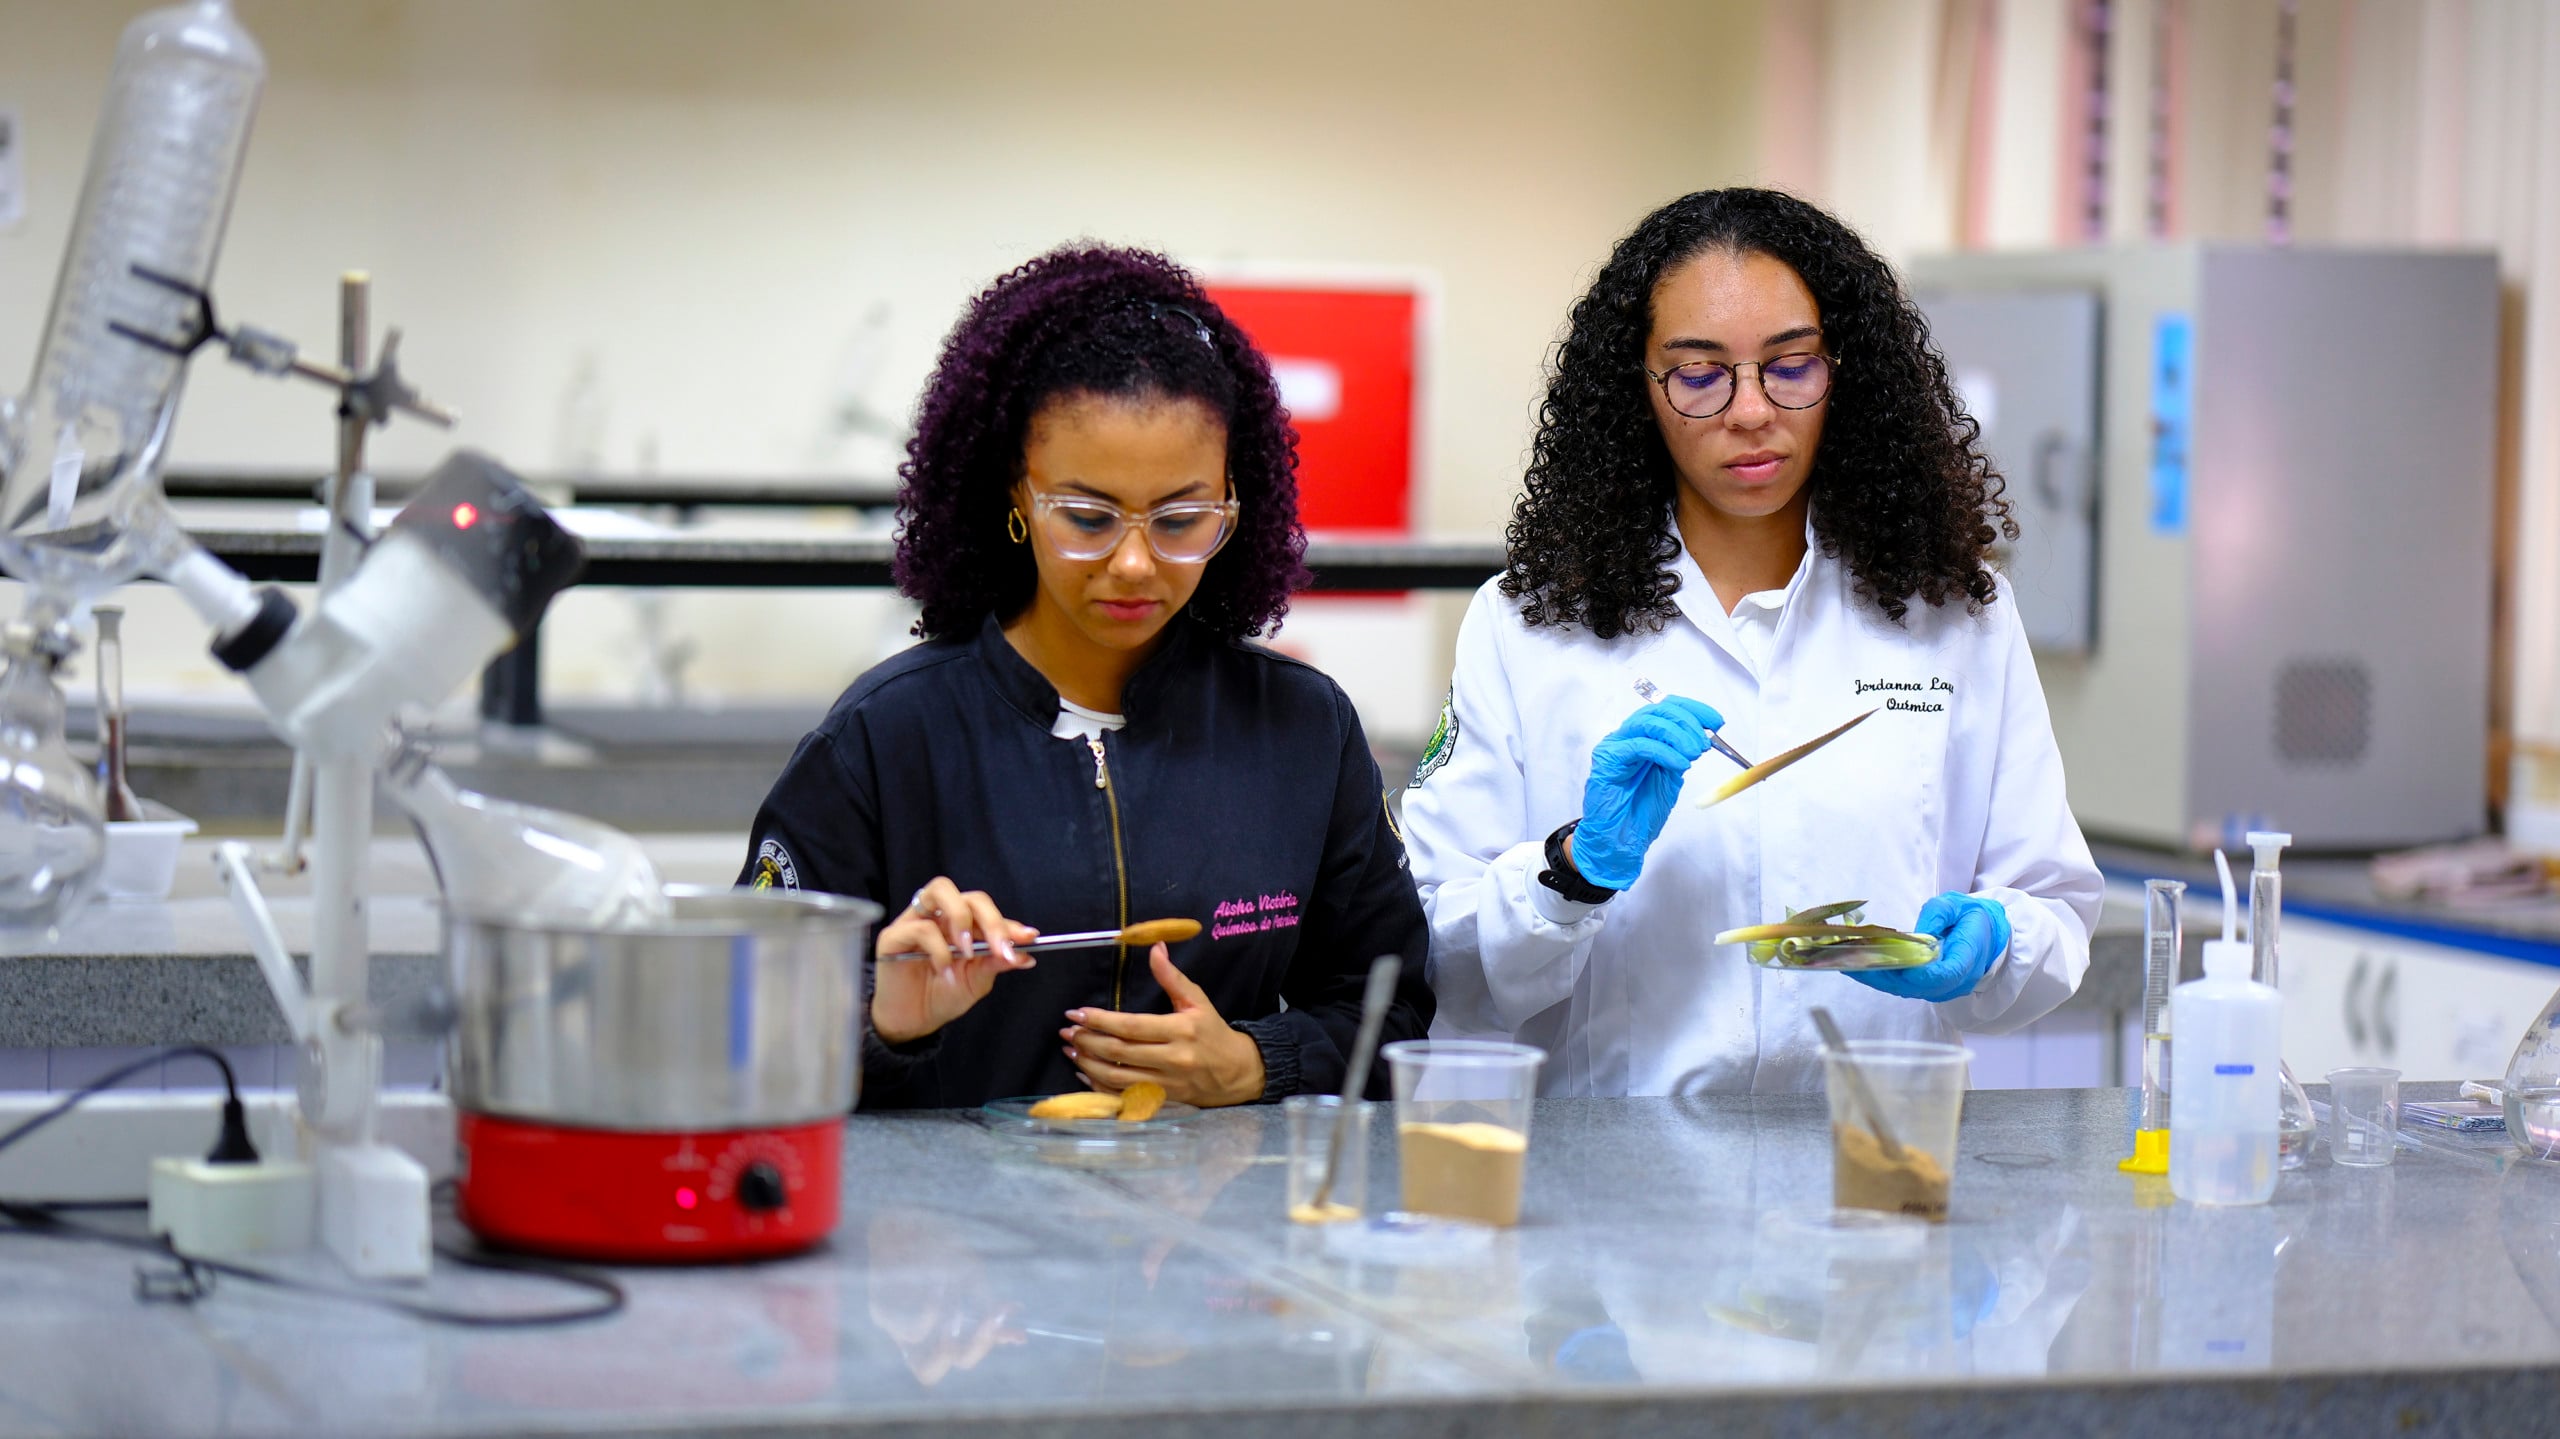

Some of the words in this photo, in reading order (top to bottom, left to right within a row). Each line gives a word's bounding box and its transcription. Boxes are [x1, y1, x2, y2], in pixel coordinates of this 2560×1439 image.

[1855, 678, 1923, 695] Jordanna
[1886, 698, 1944, 713] Química
[776, 851, 788, 866] DO
[1214, 898, 1256, 919] Aisha
